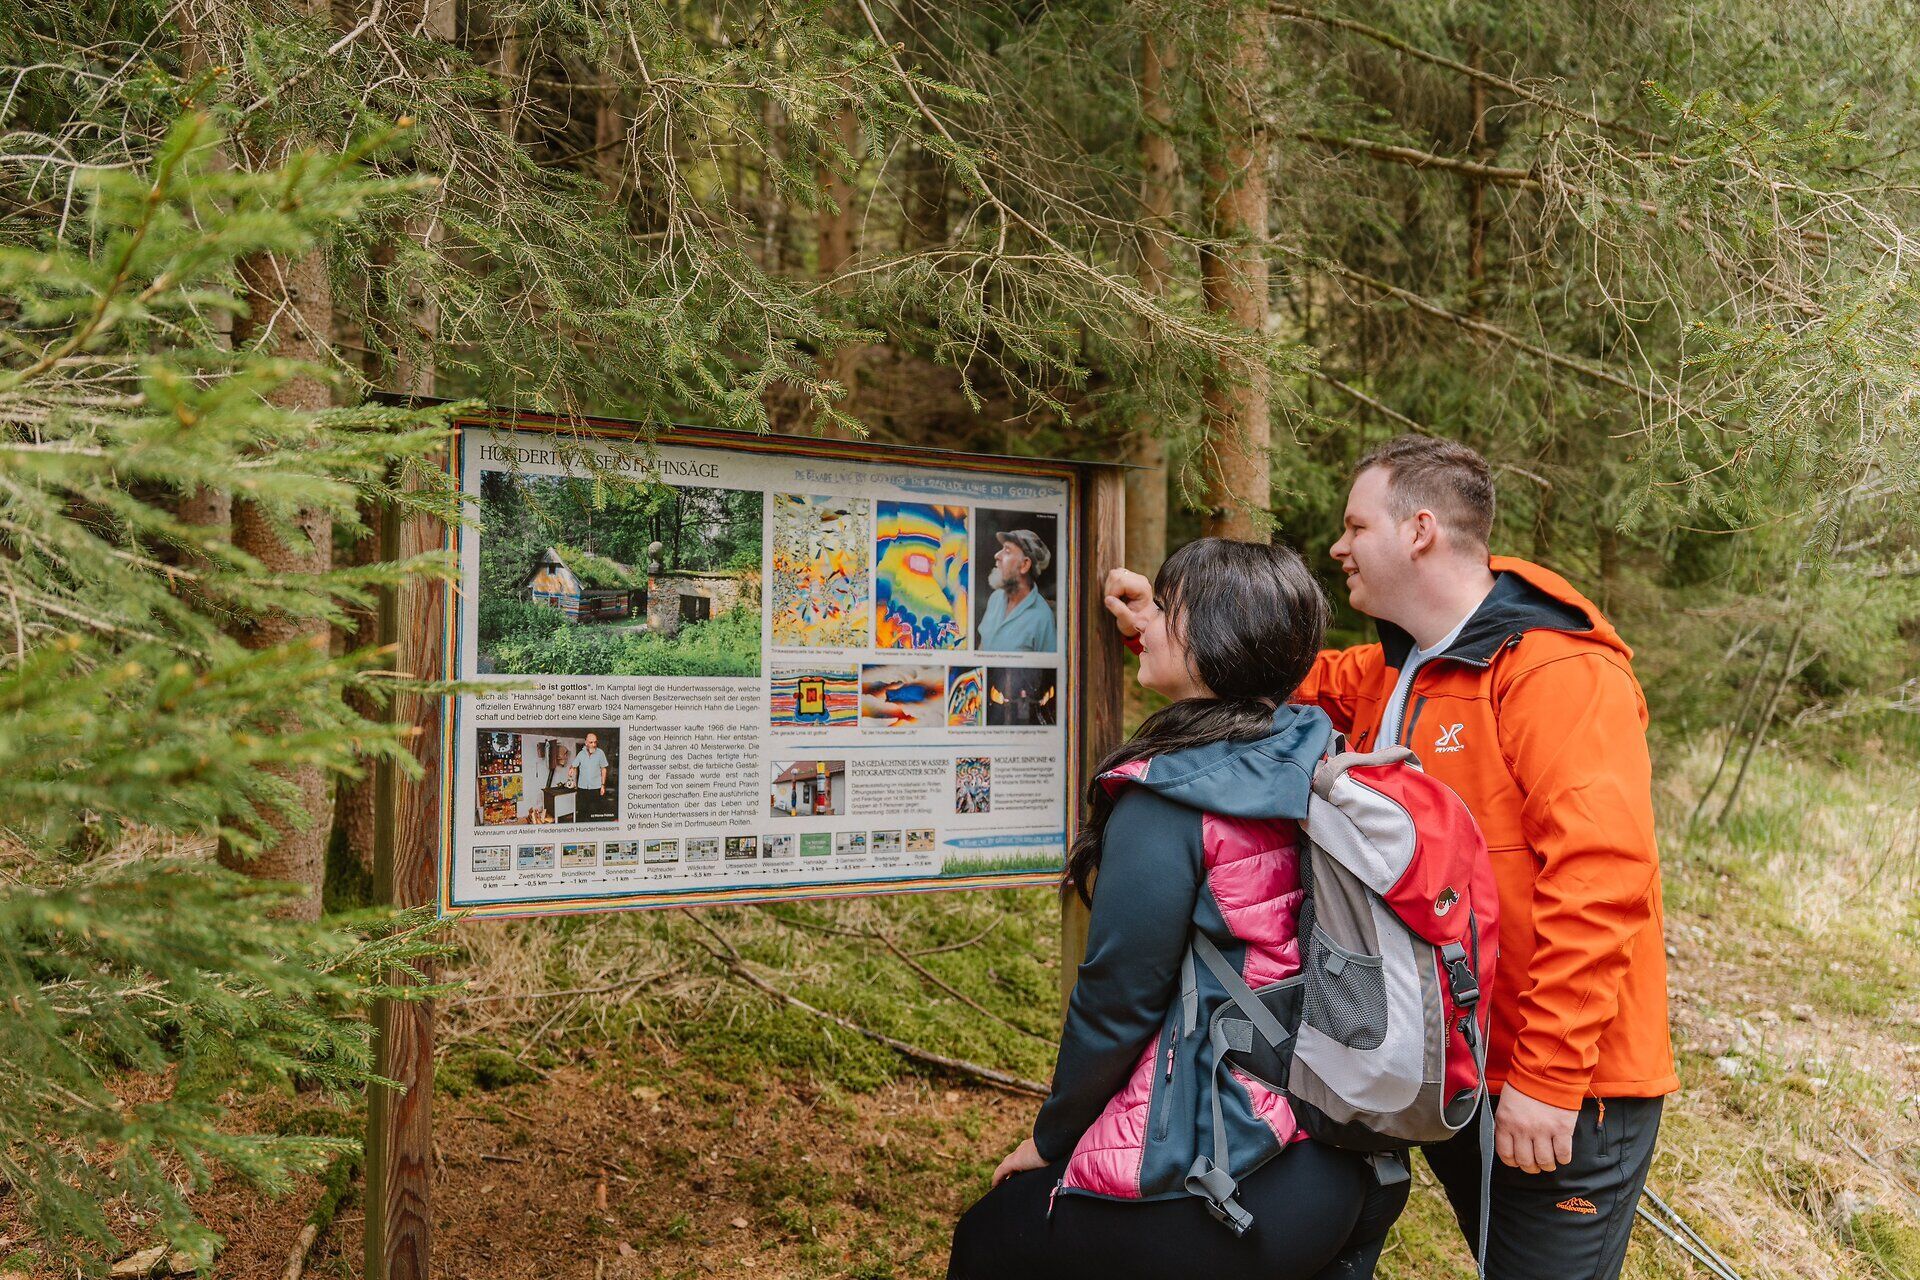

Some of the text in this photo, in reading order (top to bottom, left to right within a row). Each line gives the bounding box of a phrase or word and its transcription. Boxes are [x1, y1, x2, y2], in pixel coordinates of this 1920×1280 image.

[480, 445, 630, 472] HUDERTWASERS
[514, 703, 555, 712] Erwähnung
[628, 754, 666, 762] Begrünung
